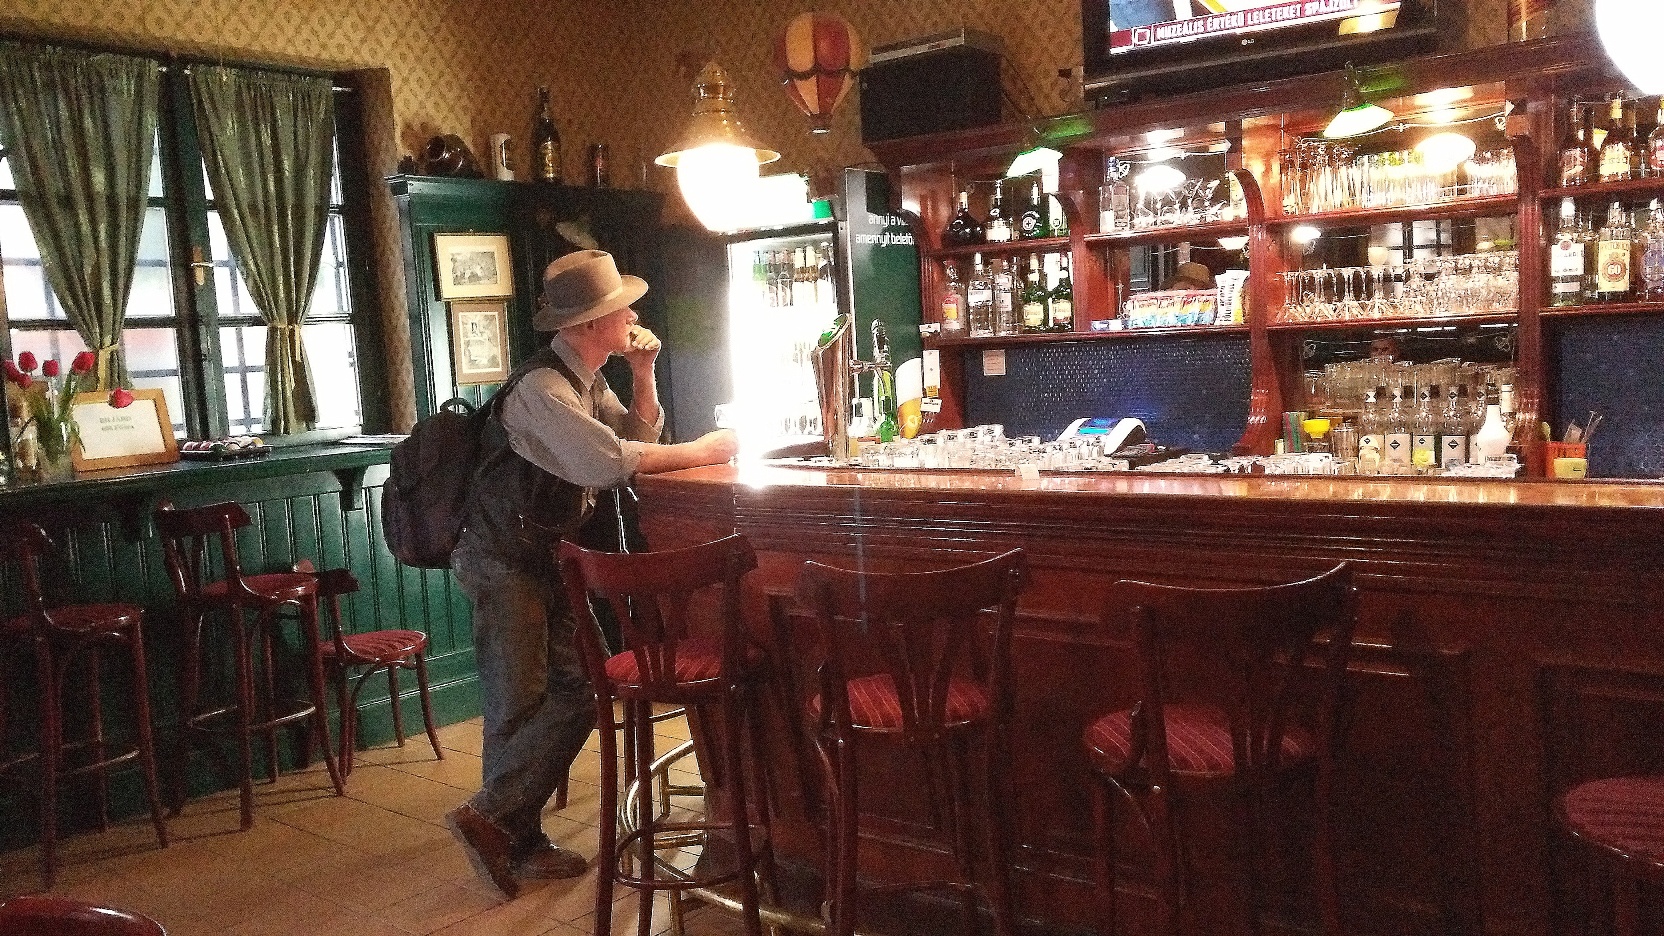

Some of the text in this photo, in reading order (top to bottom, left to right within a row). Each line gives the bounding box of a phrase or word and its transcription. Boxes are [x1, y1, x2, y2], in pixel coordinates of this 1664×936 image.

[1246, 3, 1302, 25] LELETEKET
[868, 212, 890, 227] annyi
[890, 215, 896, 226] a
